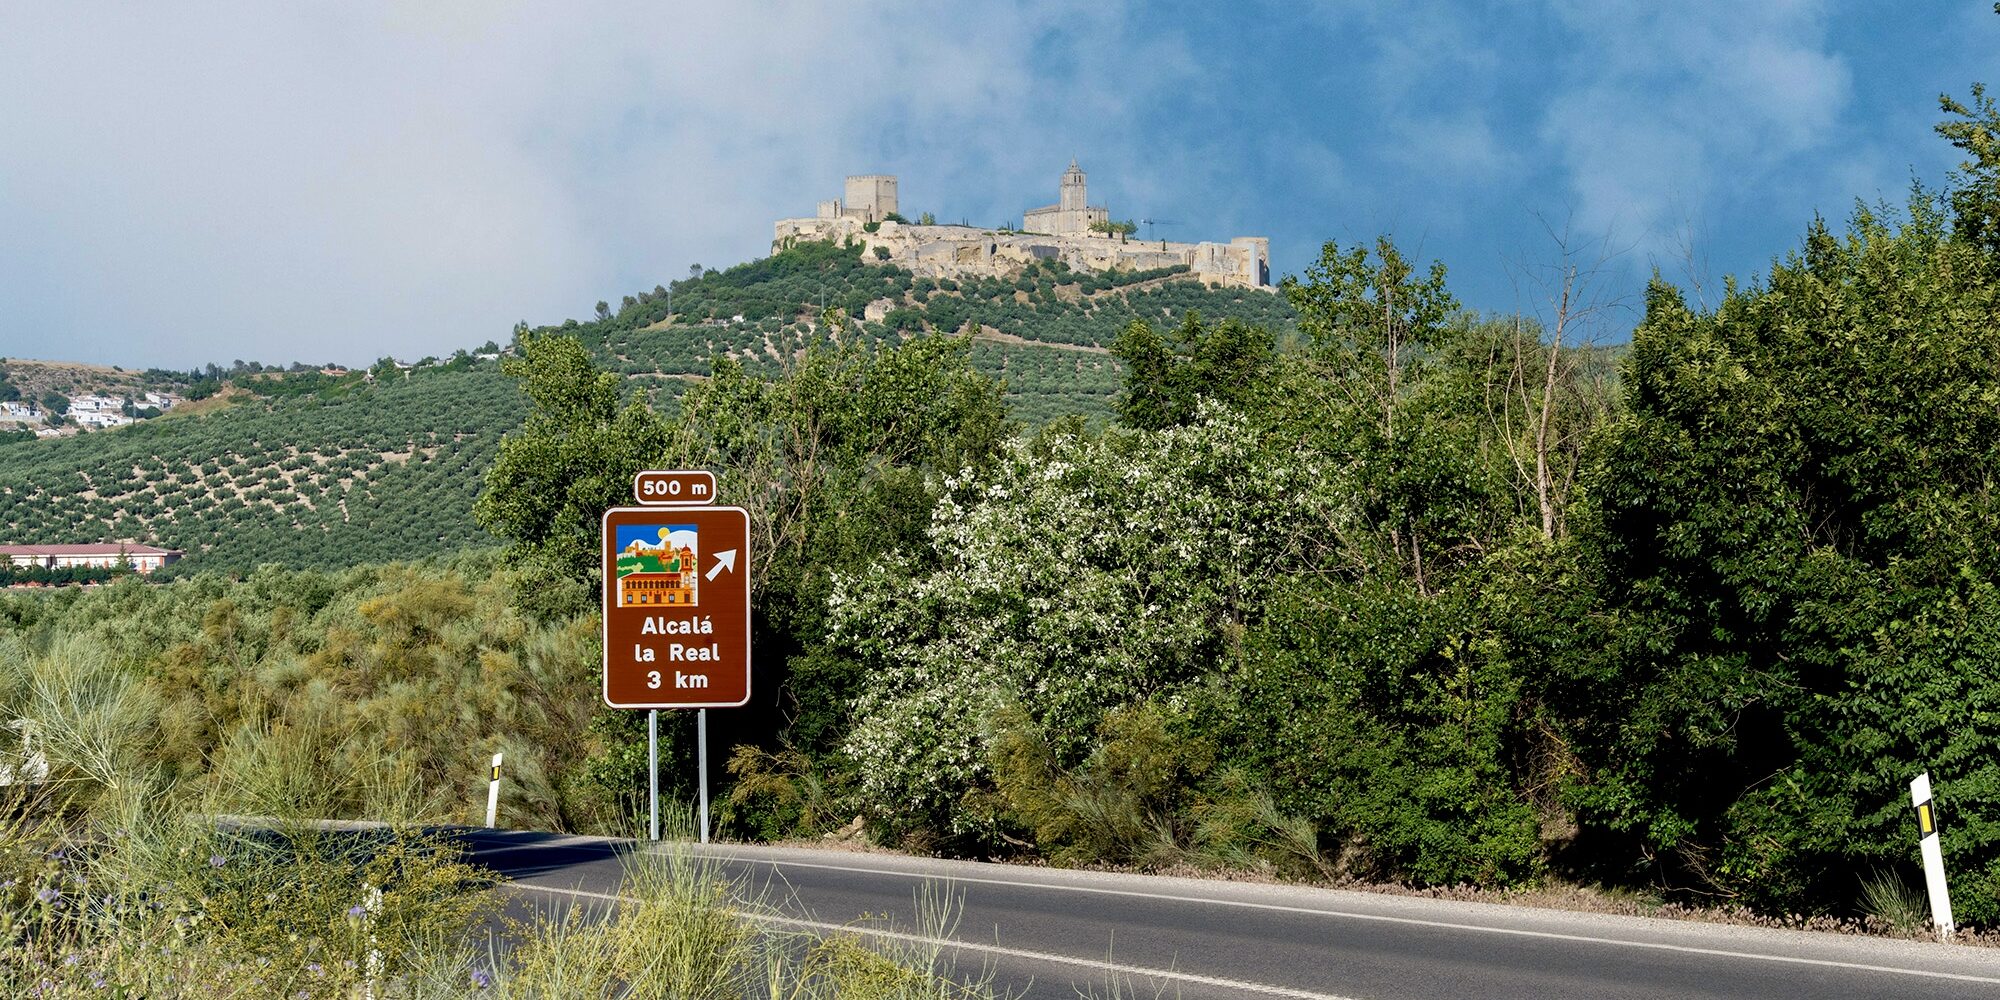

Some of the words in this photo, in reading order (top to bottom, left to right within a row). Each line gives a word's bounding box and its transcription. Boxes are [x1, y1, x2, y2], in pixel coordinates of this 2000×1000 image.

[643, 480, 681, 496] 500
[691, 483, 707, 495] m
[641, 615, 713, 635] Alcalá
[634, 643, 656, 662] la
[669, 643, 720, 662] Real
[647, 670, 662, 689] 3
[675, 670, 708, 689] km
